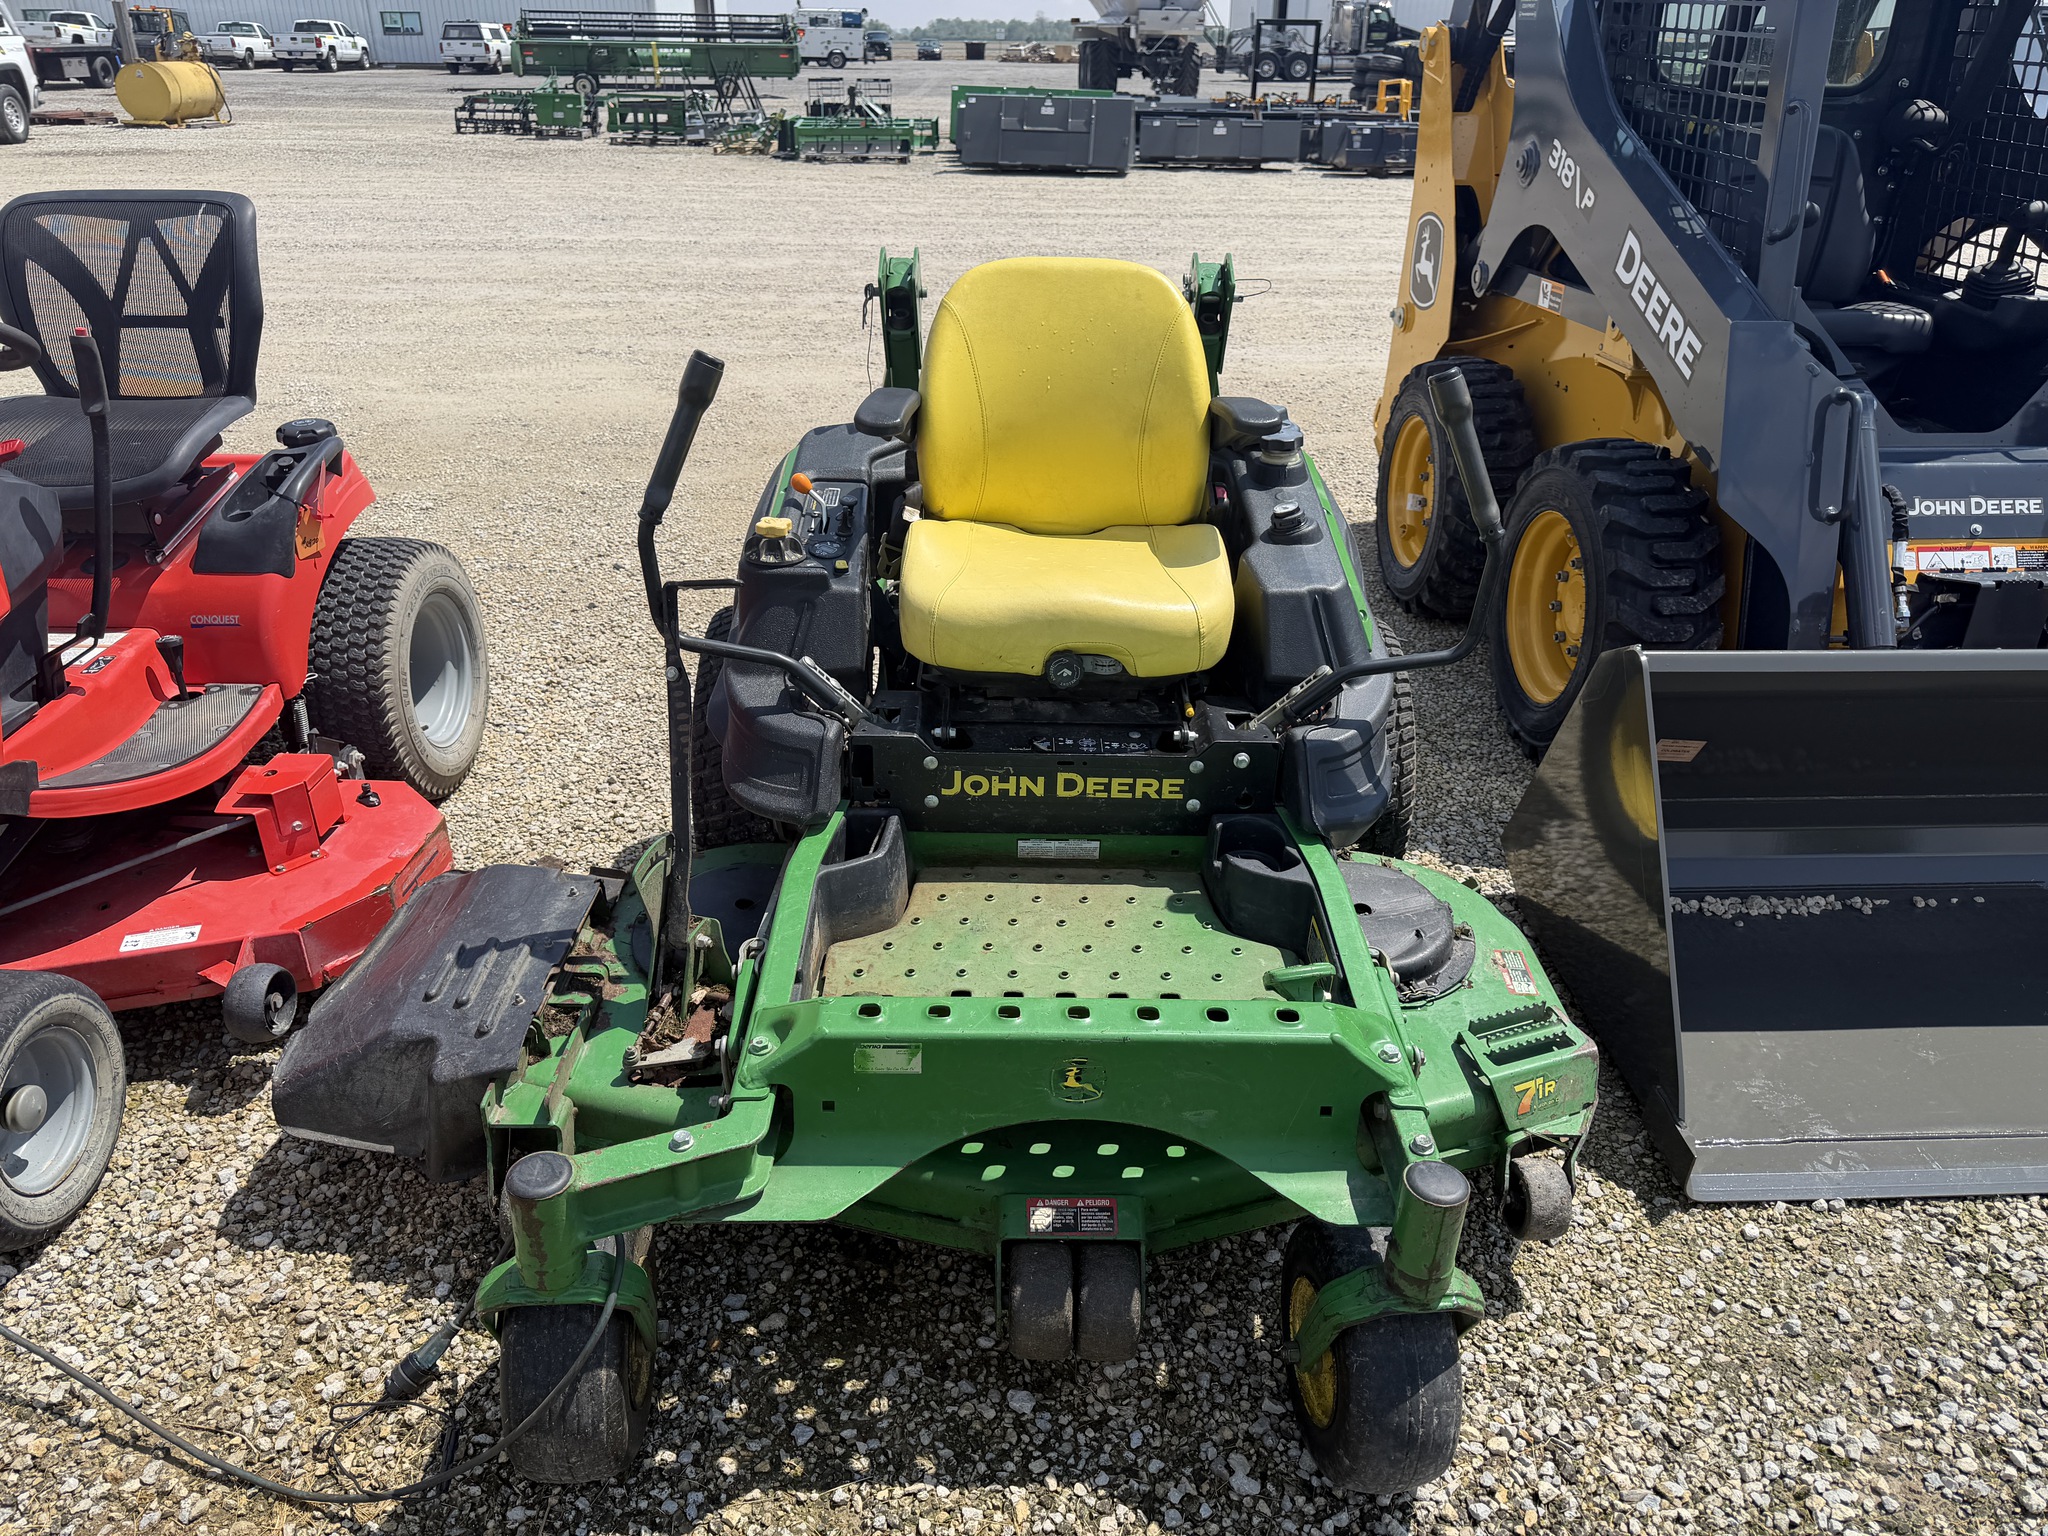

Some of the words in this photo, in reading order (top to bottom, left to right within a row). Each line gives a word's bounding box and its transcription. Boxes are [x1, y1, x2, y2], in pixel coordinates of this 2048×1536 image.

[1615, 230, 1702, 380] DEERE
[1909, 498, 1965, 515] JOHN
[1970, 498, 2042, 515] DEERE
[190, 615, 240, 625] CONQUEST
[941, 770, 1045, 797] JOHN
[1056, 772, 1185, 799] DEERE
